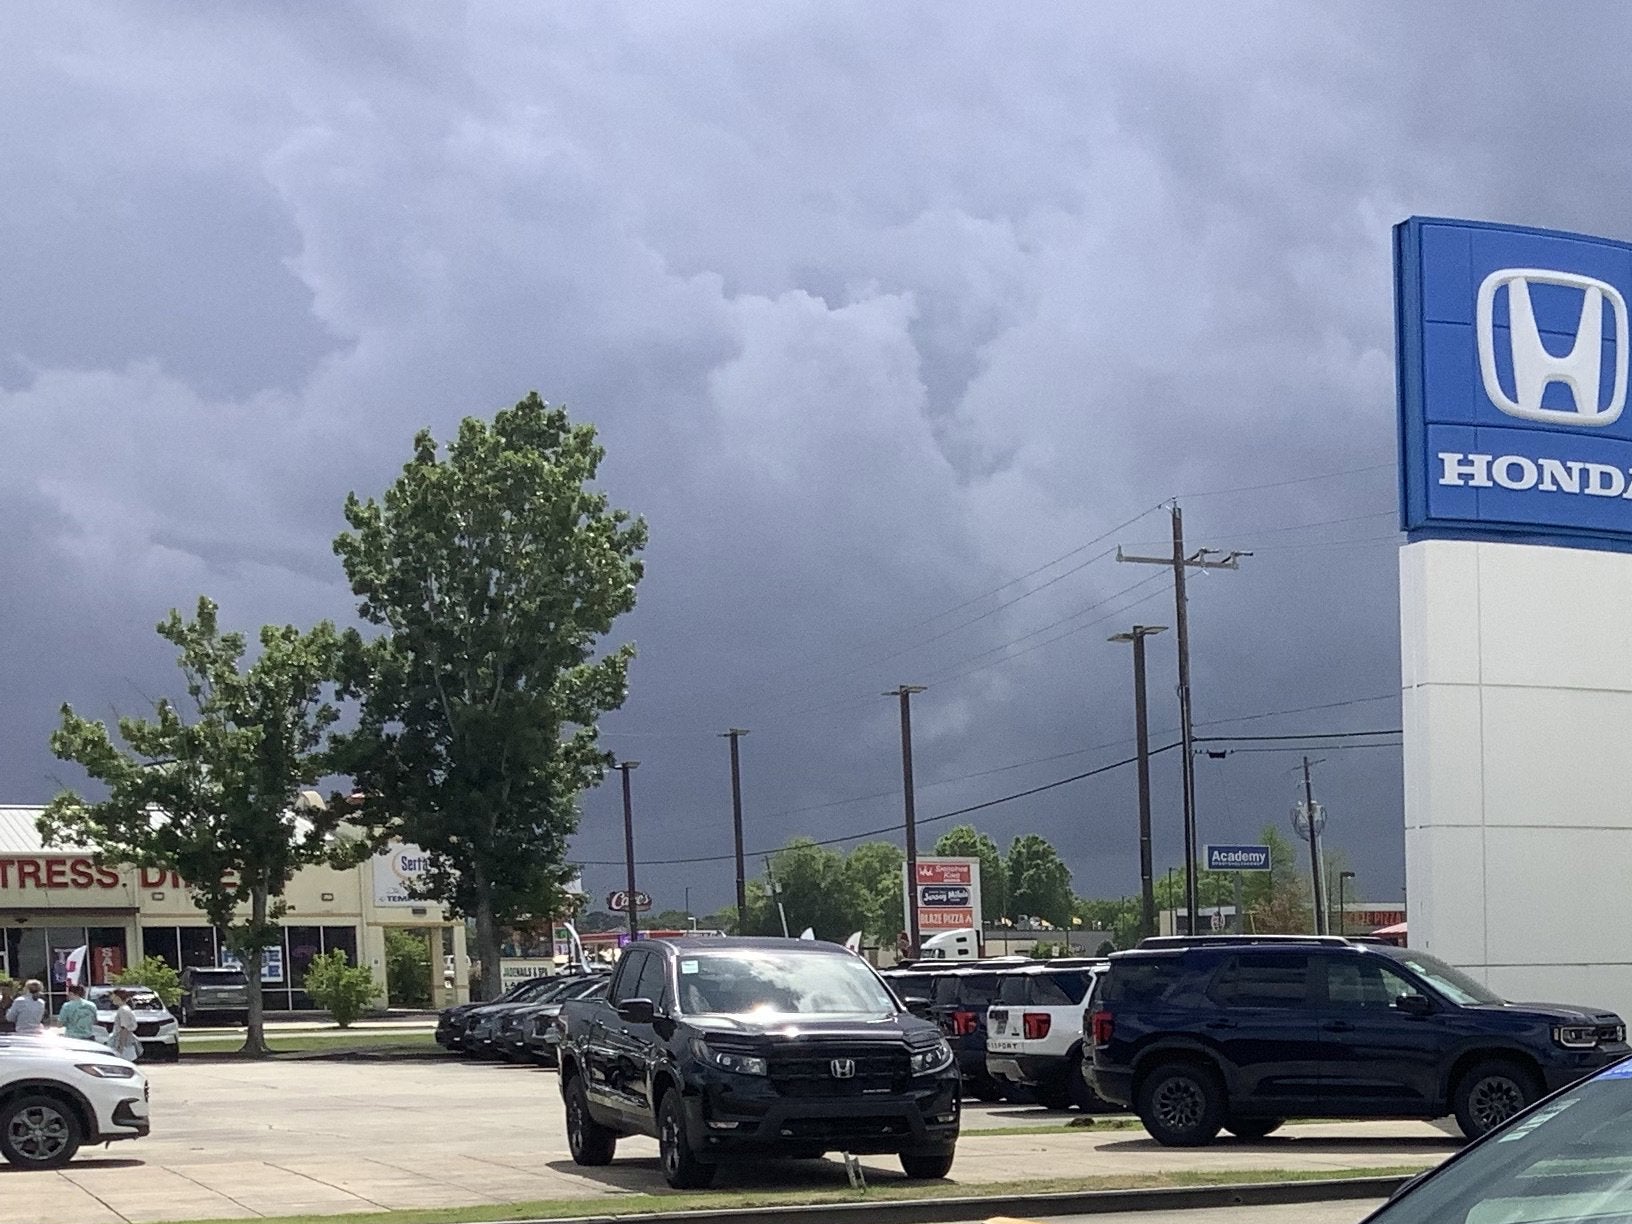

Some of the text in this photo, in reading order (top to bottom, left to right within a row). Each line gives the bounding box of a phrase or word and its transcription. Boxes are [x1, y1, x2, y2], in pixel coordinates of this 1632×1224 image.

[1212, 850, 1266, 865] Academy
[0, 859, 119, 889] TRESS
[611, 891, 649, 909] Cae's
[920, 912, 964, 924] BLAZE PIZZA
